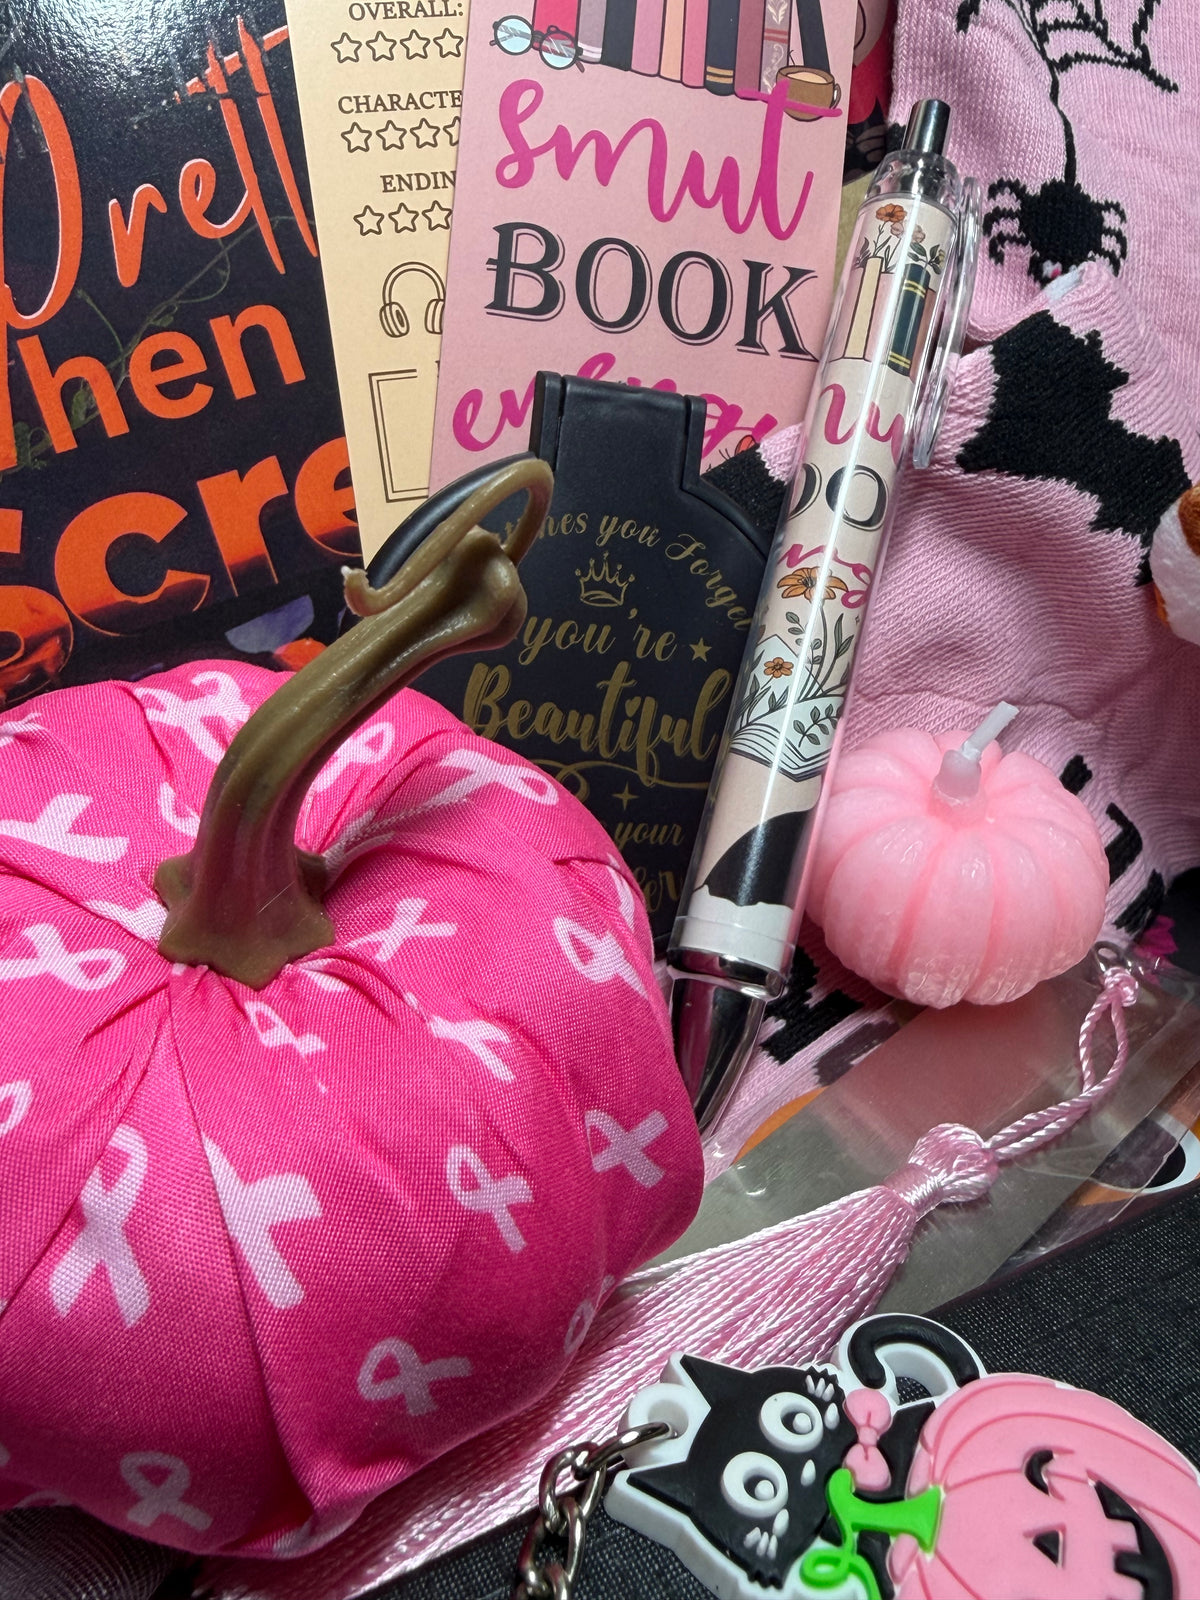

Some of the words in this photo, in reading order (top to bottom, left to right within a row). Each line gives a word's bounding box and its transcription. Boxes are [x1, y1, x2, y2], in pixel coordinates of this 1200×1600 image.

[348, 0, 464, 21] OVERALL:
[485, 222, 820, 363] BOOK
[0, 304, 306, 471] hen
[595, 513, 662, 548] you
[518, 607, 679, 666] you're
[463, 660, 733, 787] Beautiful
[610, 821, 686, 851] your
